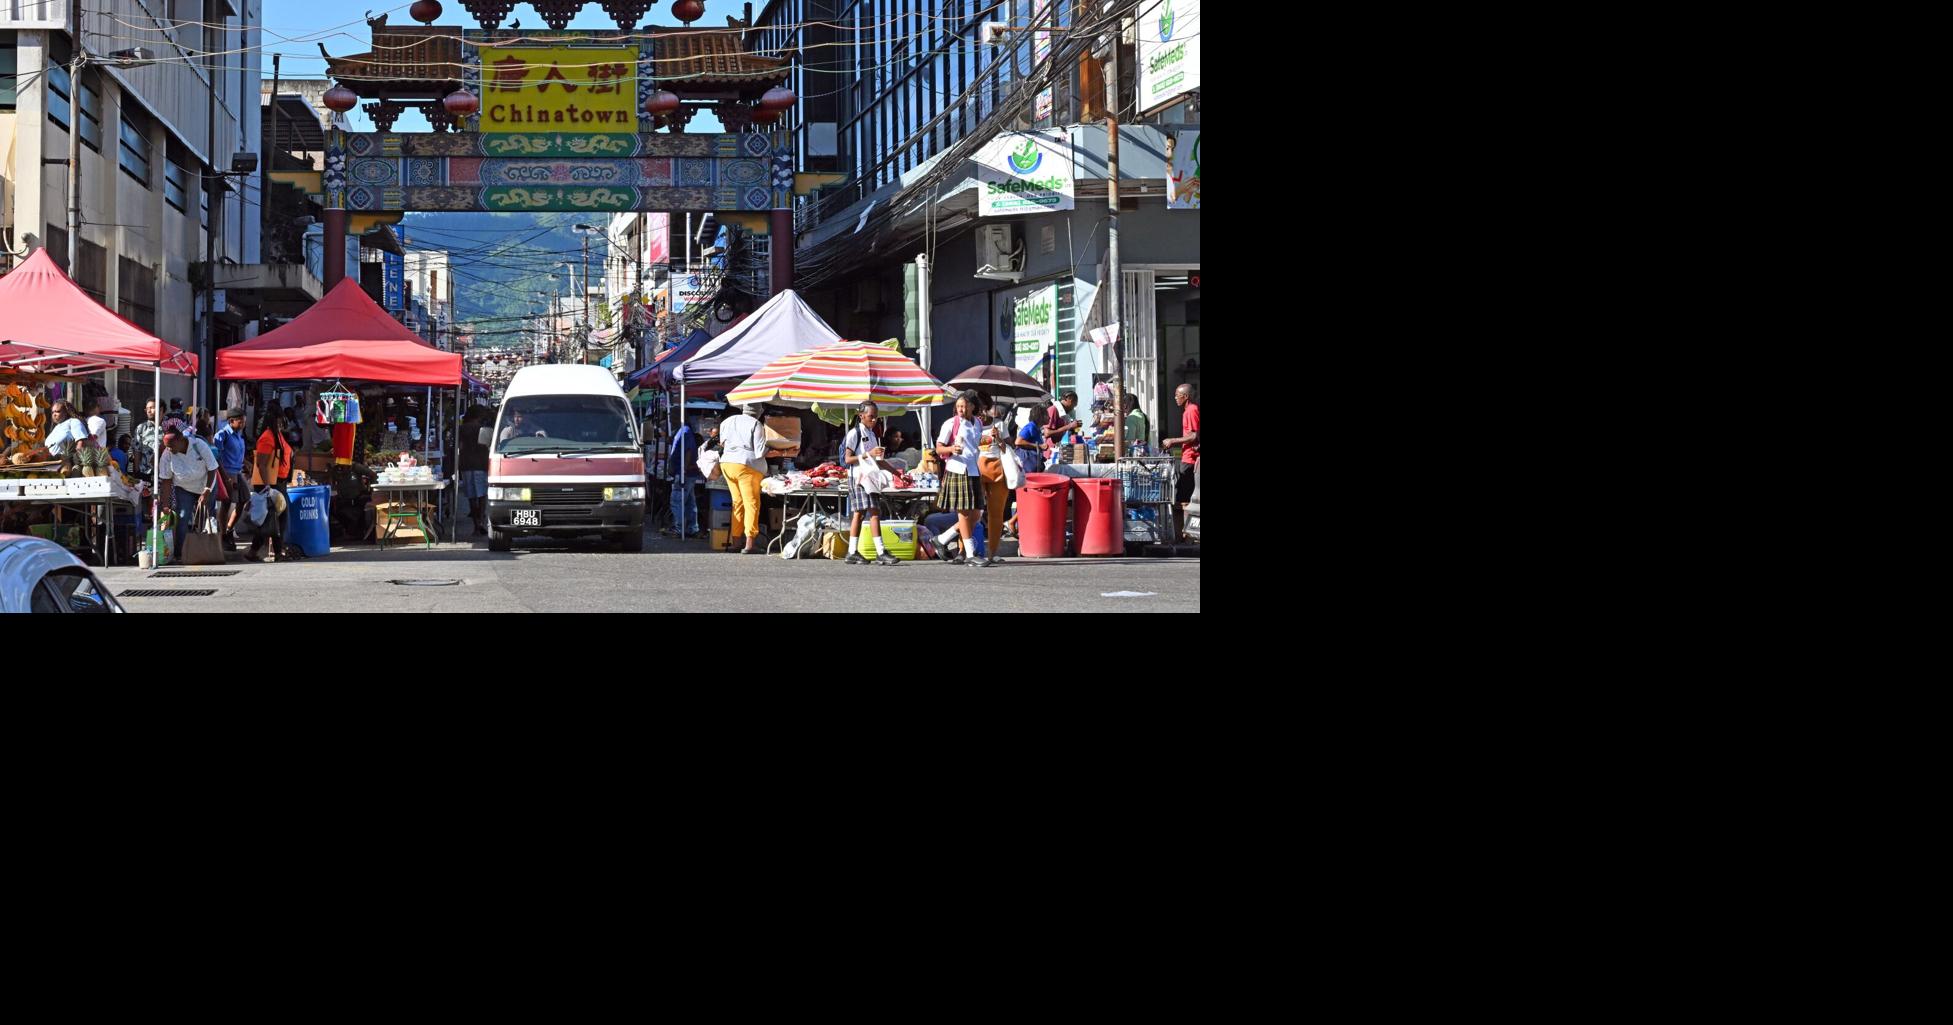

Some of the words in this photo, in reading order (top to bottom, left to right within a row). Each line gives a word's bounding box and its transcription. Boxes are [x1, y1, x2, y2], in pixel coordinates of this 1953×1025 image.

[489, 54, 629, 95] 唐人街
[489, 104, 629, 123] Chinatown
[987, 176, 1064, 195] SafeMeds
[301, 496, 316, 508] COLD
[513, 517, 539, 526] 6948
[516, 510, 536, 518] HBU
